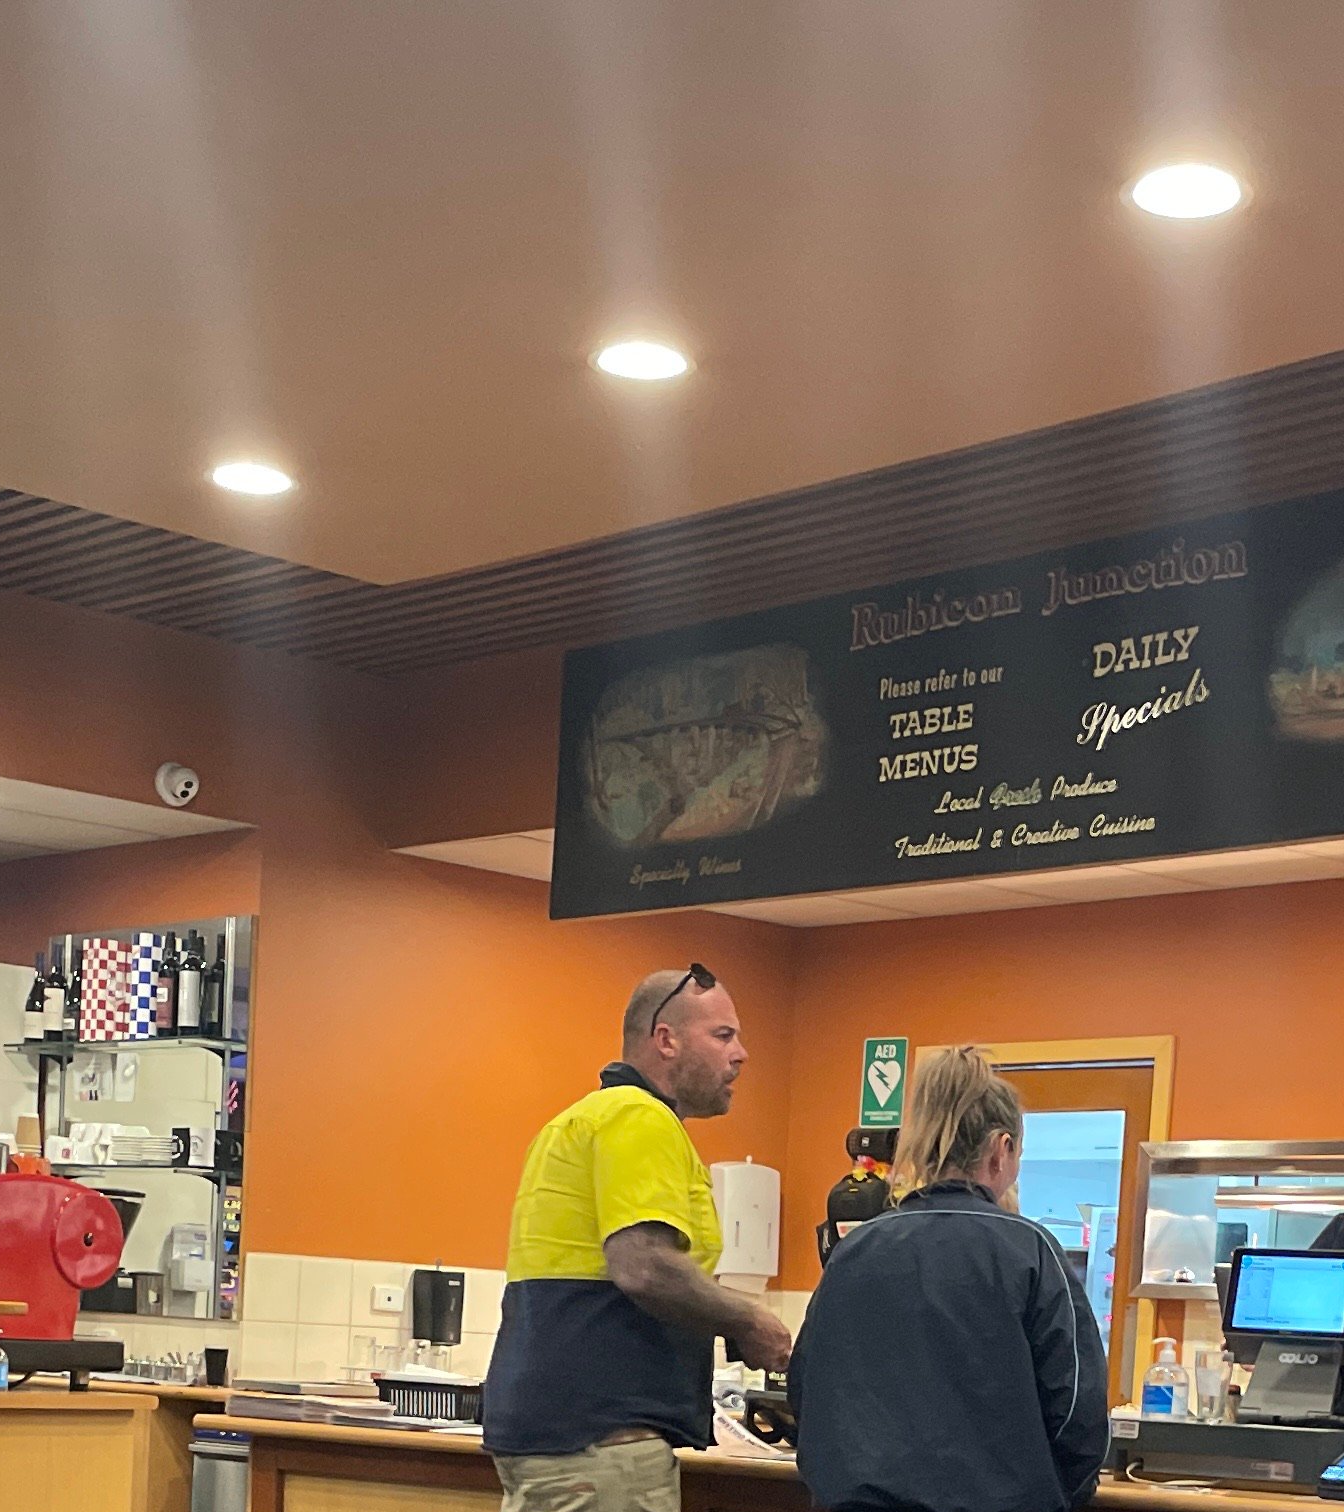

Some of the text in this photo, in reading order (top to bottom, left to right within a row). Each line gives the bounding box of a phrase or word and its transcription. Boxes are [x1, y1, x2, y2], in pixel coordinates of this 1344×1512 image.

[849, 537, 1248, 652] Rubicon Junction
[1092, 626, 1200, 679] DAILY
[880, 666, 1004, 700] Please refer to our
[890, 703, 974, 739] TABLE
[1076, 668, 1210, 751] Specials
[878, 744, 979, 782] MENUS
[934, 786, 985, 814] Local
[1050, 773, 1118, 803] Produce
[894, 813, 1156, 859] Traditional & Creative Cuisine
[875, 1044, 897, 1059] AED
